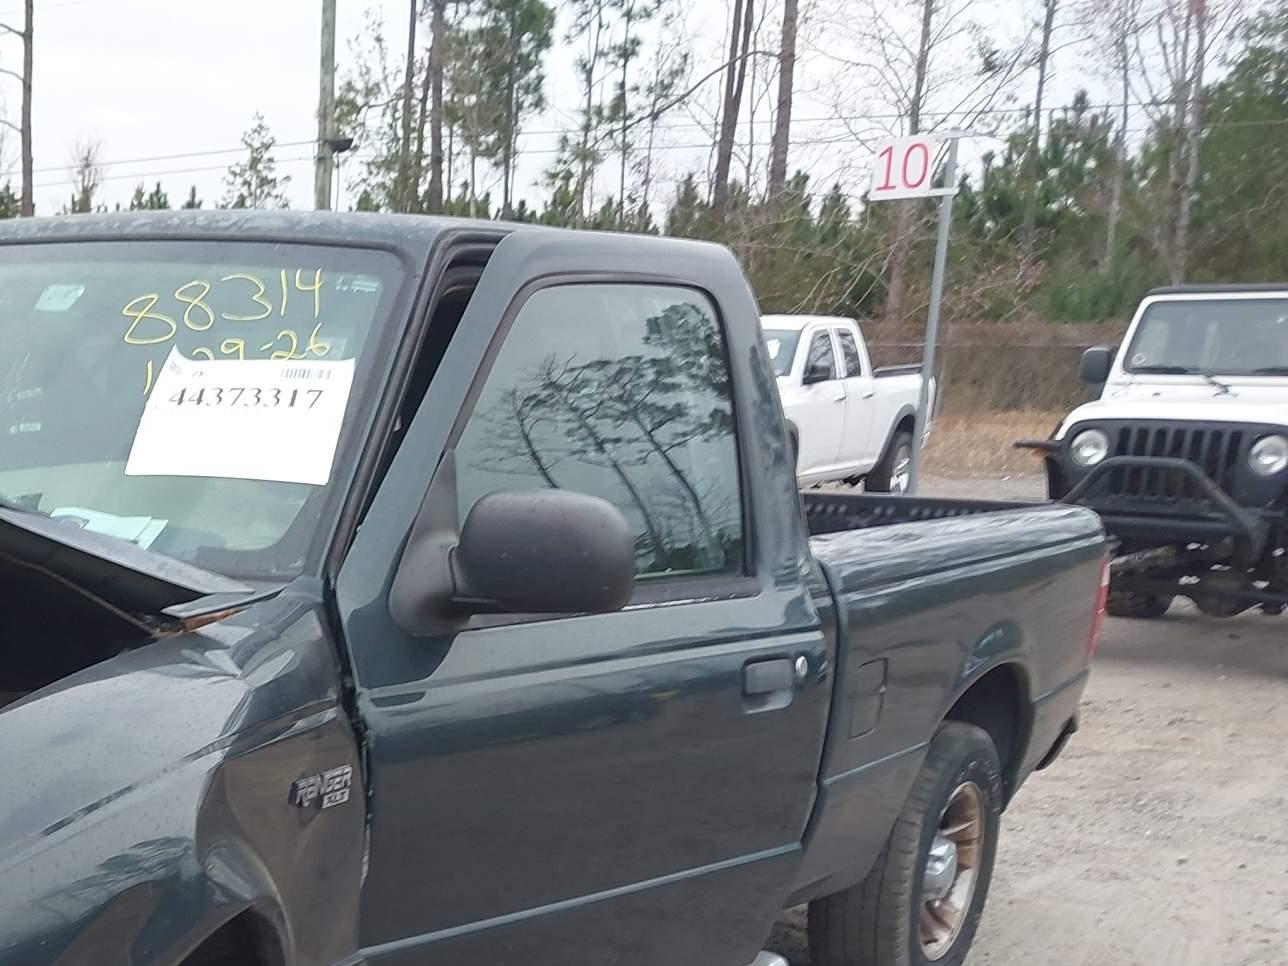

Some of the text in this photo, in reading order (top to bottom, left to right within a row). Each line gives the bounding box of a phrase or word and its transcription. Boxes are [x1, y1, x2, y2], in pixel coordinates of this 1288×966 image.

[875, 142, 929, 192] 10
[121, 267, 325, 345] 88314
[168, 386, 325, 410] 44373317
[293, 763, 353, 808] RANGER
